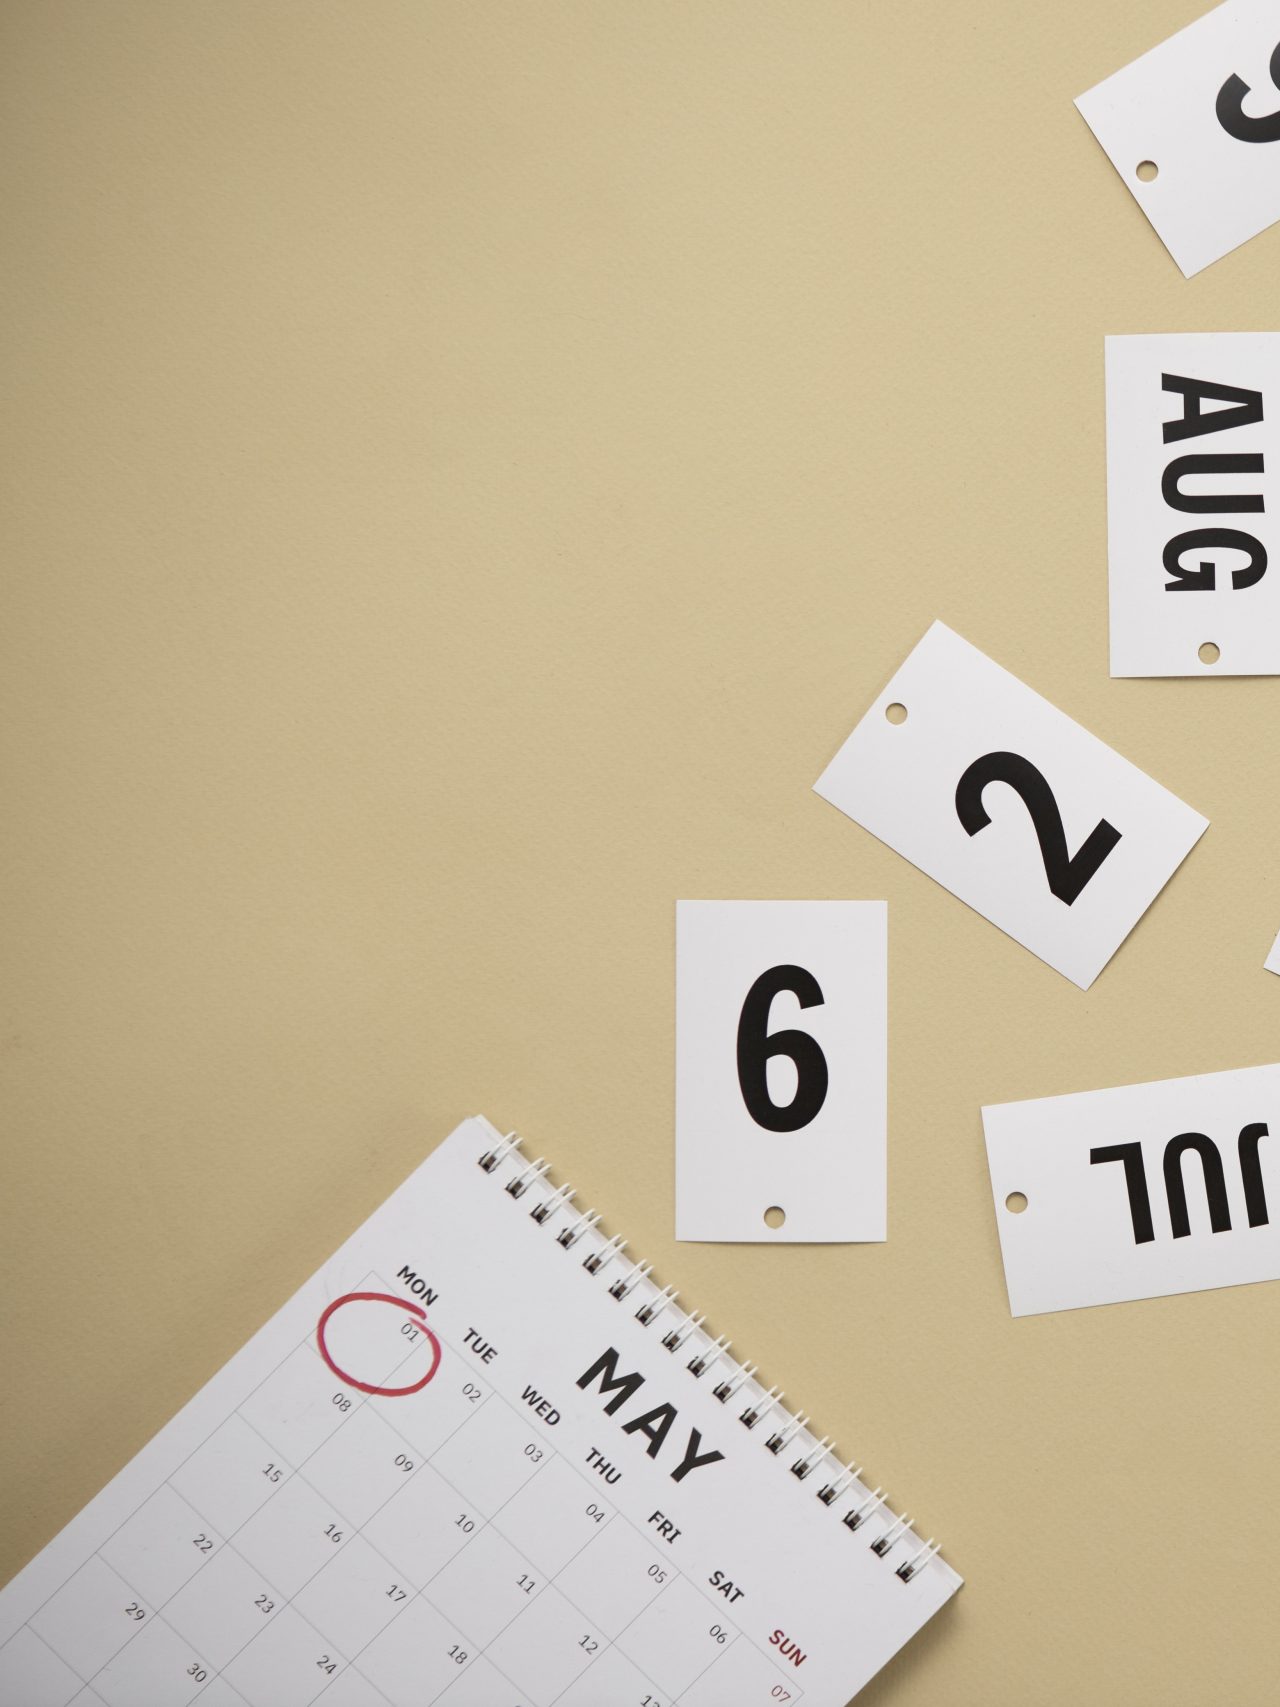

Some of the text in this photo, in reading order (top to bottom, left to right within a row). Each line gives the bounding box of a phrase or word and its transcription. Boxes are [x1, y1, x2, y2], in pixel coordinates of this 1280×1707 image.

[1161, 372, 1268, 592] AUG
[955, 751, 1123, 907] 2
[1090, 1122, 1270, 1245] JUL
[396, 1265, 807, 1667] MON TUE WED THU FRI SAT SUN
[576, 1347, 725, 1483] MAY
[262, 1464, 468, 1665] 15 16 17 18
[332, 1393, 351, 1412] 08
[394, 1454, 414, 1473] 09
[455, 1514, 475, 1533] 10
[516, 1575, 535, 1594] 11
[578, 1635, 598, 1655] 12
[400, 1322, 791, 1704] 01 02 03 04 05 06 07
[124, 1602, 207, 1683] 29 30
[193, 1533, 337, 1675] 22 23 24
